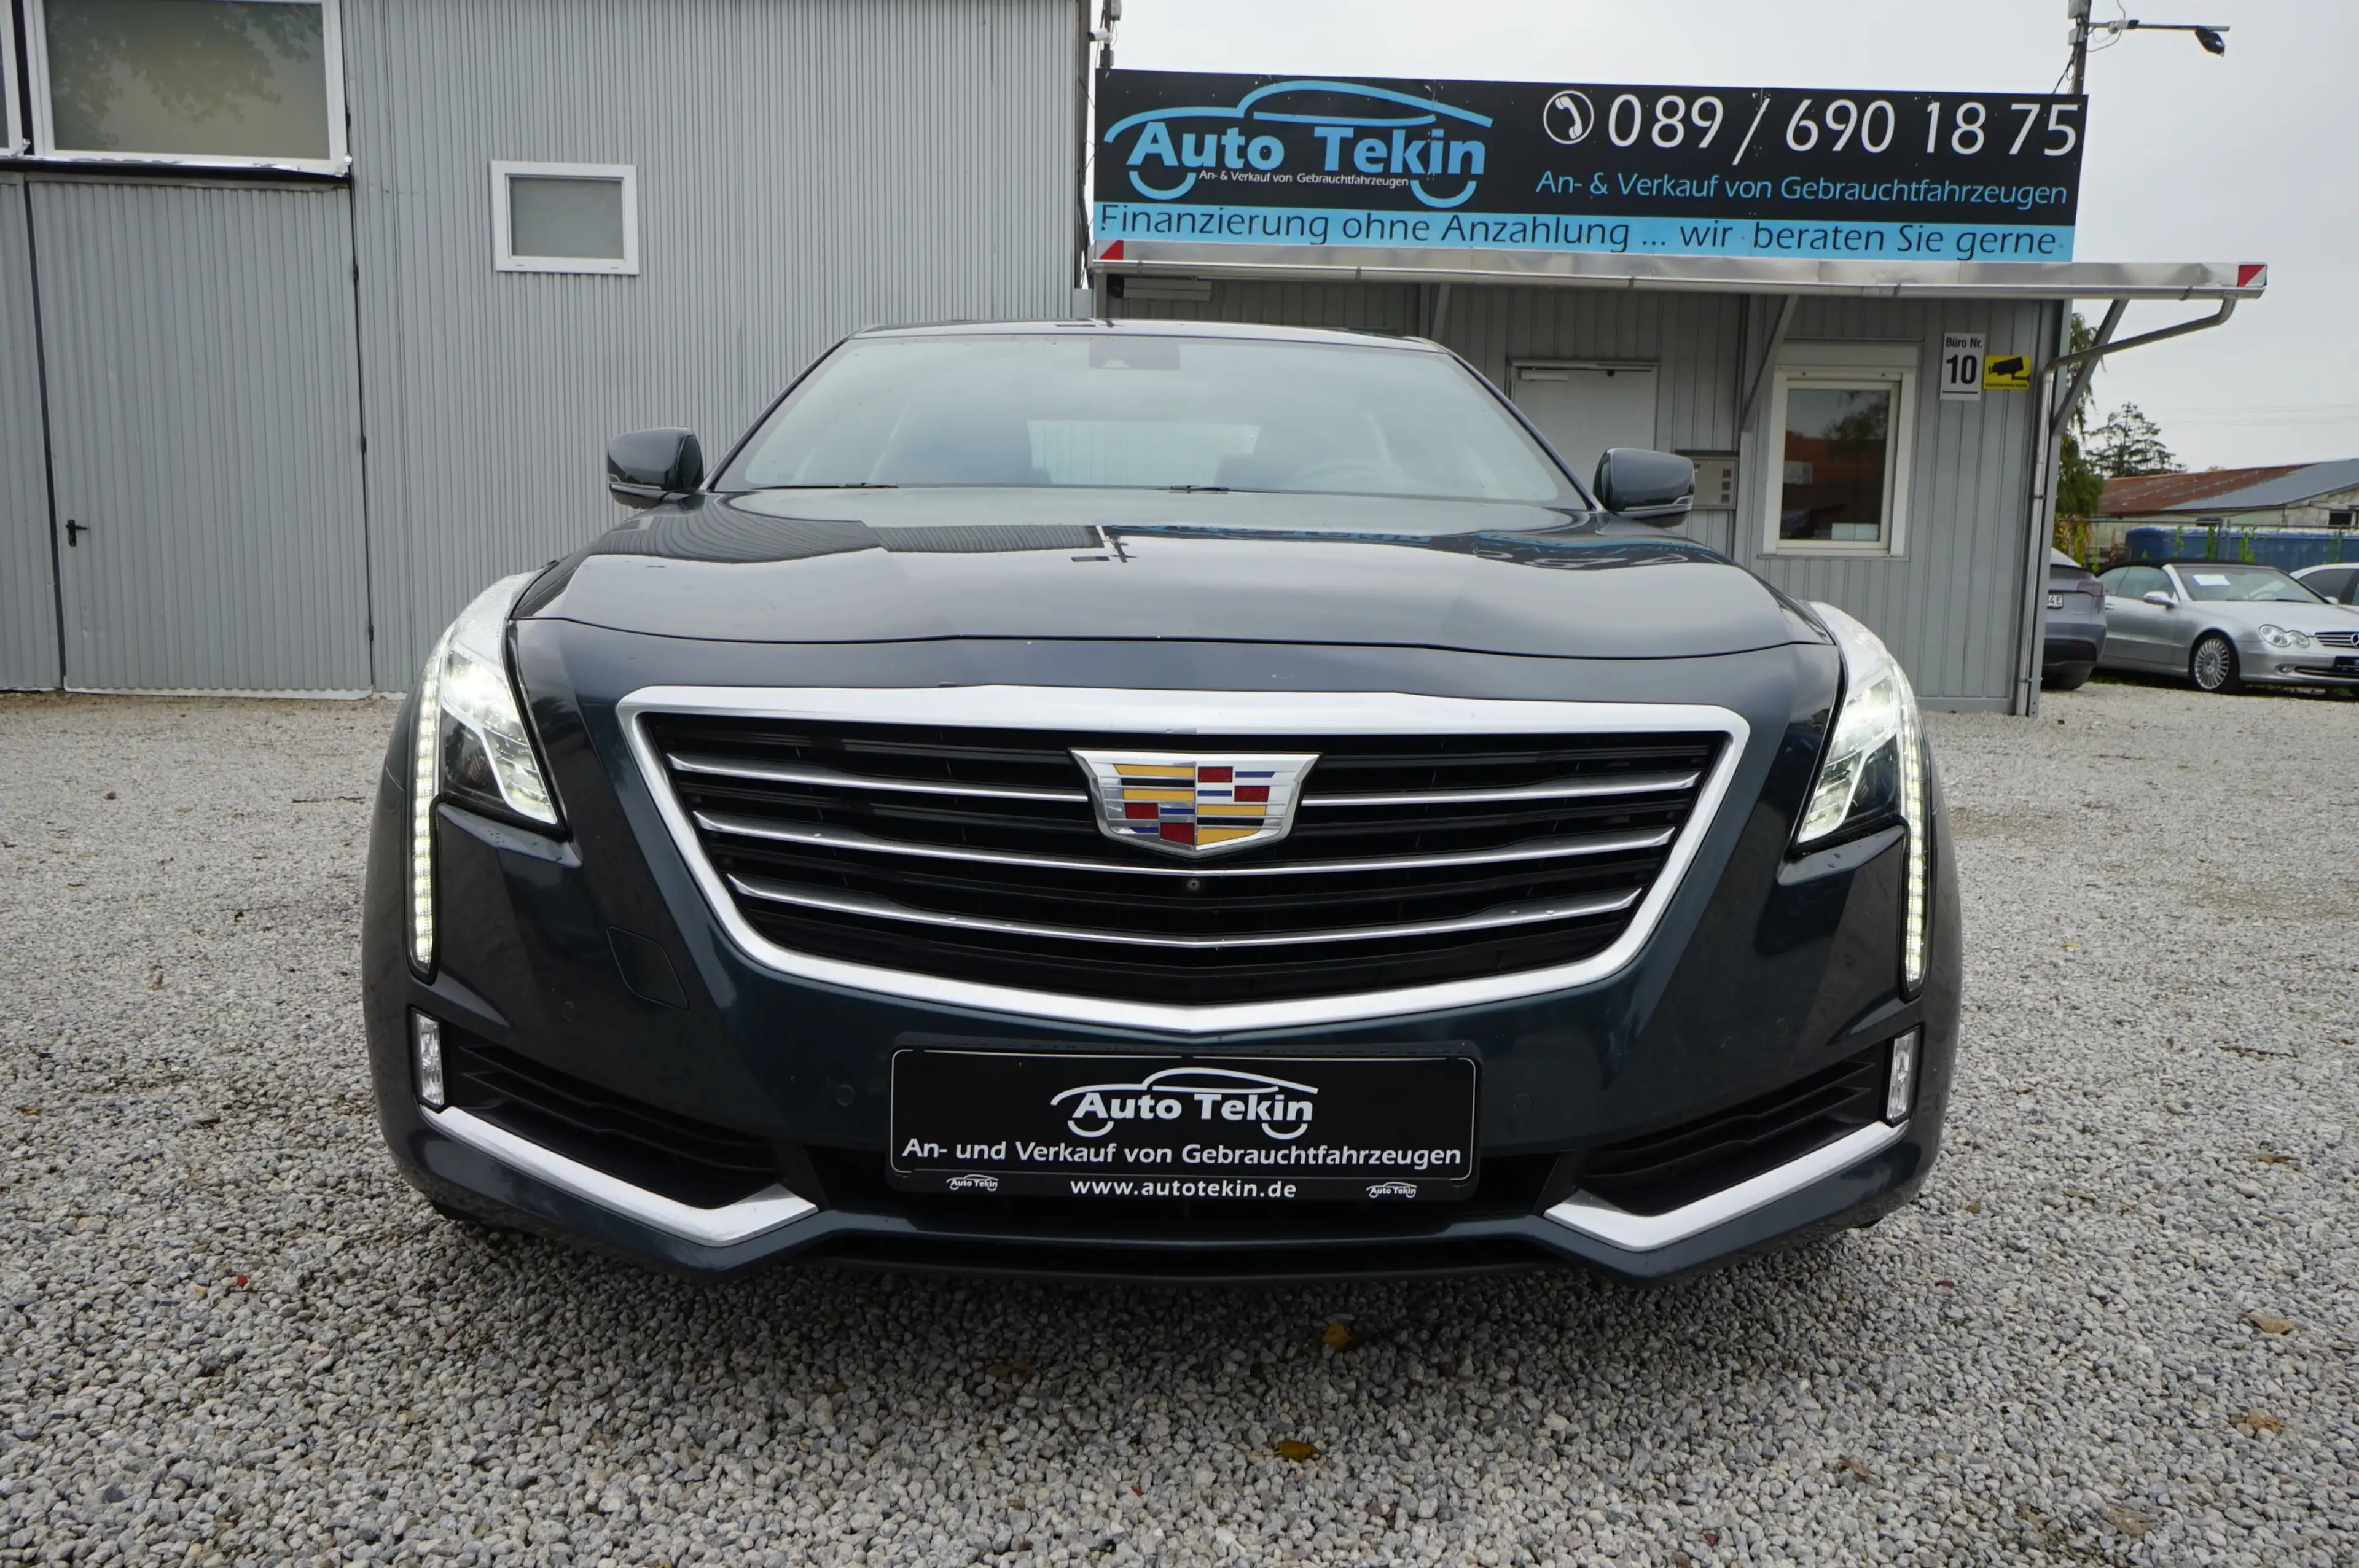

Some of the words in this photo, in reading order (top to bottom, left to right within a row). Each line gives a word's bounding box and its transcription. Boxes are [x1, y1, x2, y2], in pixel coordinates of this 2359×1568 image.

[1608, 93, 1724, 149] 089
[1785, 99, 1895, 154] 690
[1925, 101, 1986, 155] 18
[2008, 103, 2079, 157] 75
[1126, 121, 1285, 170] Auto
[1314, 126, 1485, 174] Tekin
[1199, 170, 1218, 180] An-
[1220, 170, 1228, 181] &
[1230, 171, 1271, 182] Verkauf
[1297, 173, 1409, 189] Gebrauchtfahrzeugen
[1536, 171, 1582, 193] An-
[1590, 172, 1608, 194] &
[1618, 173, 1719, 197] Verkauf
[1725, 181, 1772, 198] von
[1780, 176, 2068, 211] Gebrauchtfahrzeugen
[1101, 204, 1329, 245] Finanzierung
[1342, 213, 1430, 241] ohne
[1441, 214, 1630, 252] Anzahlung
[1679, 220, 1733, 247] wir
[1753, 222, 1885, 251] beraten
[1896, 225, 1944, 252] Sie
[1955, 232, 2056, 261] gerne
[1946, 337, 1966, 348] Büro
[1970, 338, 1982, 348] Nr.
[1946, 354, 1978, 384] 10
[1072, 1092, 1183, 1120] Auto
[1194, 1094, 1313, 1122] Tekin
[902, 1138, 947, 1158] An-
[956, 1141, 1006, 1160] und
[1015, 1142, 1117, 1163] Verkauf
[1124, 1147, 1172, 1163] von
[1182, 1144, 1461, 1170] Gebrauchtfahrzeugen
[974, 1179, 998, 1188] Tekin
[1070, 1180, 1297, 1198] www.autotekin.de
